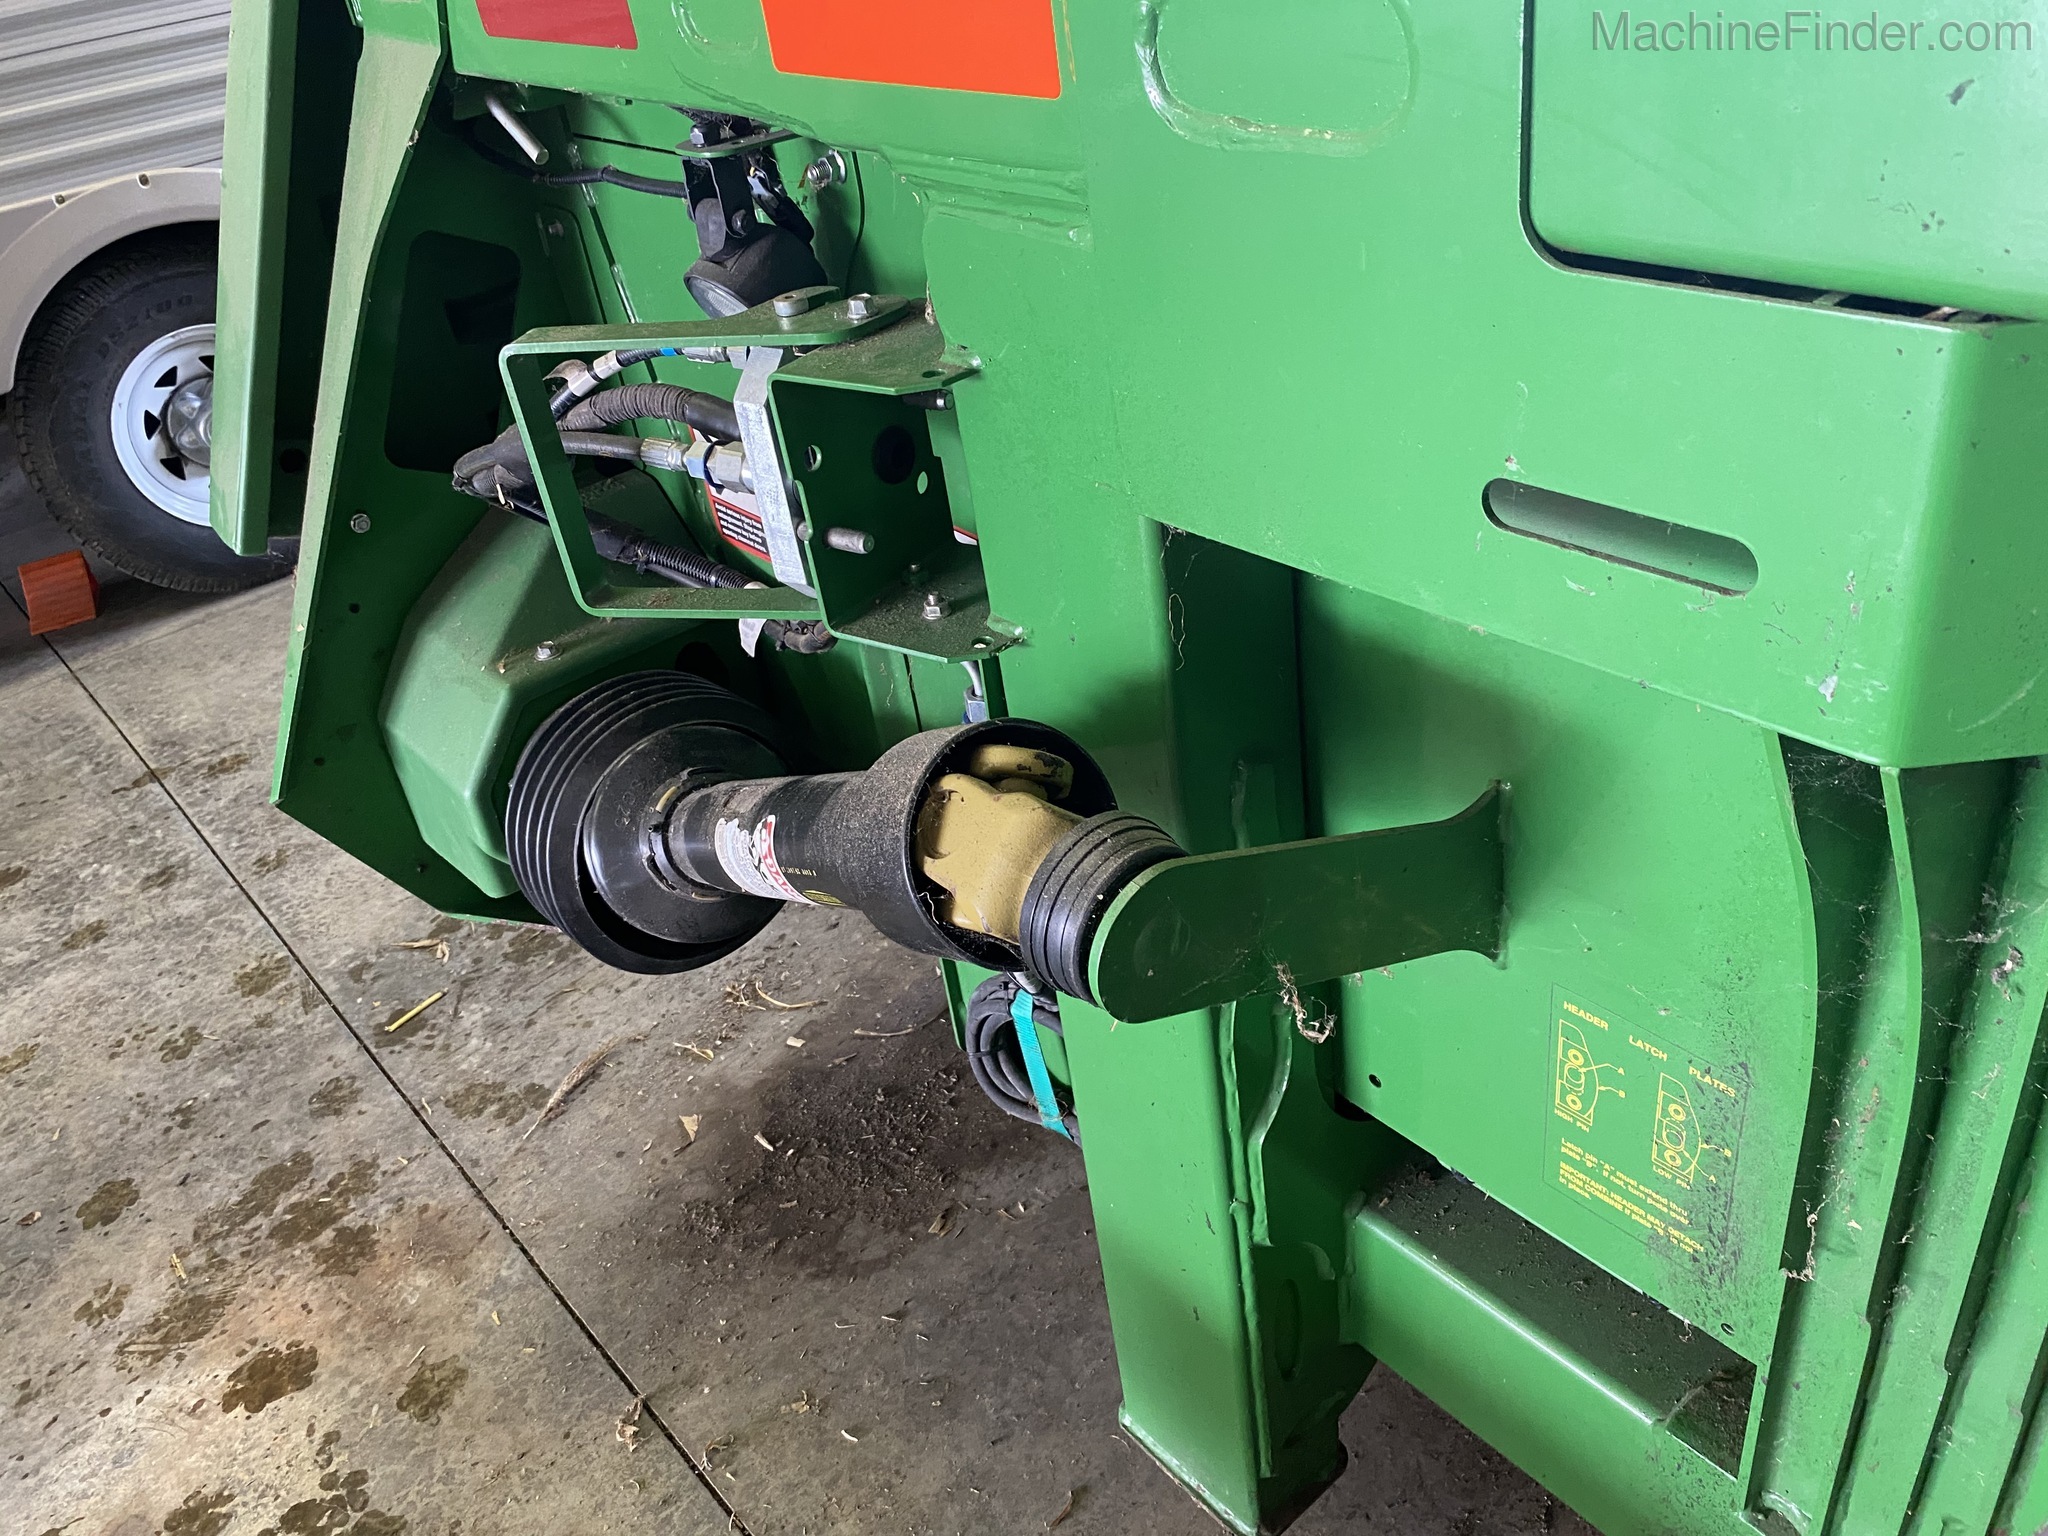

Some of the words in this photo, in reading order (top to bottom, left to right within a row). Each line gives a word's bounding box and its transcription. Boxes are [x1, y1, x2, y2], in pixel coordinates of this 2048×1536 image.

[1563, 1001, 1609, 1031] HEADER
[1629, 1034, 1668, 1062] LATCH
[1688, 1066, 1736, 1098] PLATES
[1554, 1108, 1573, 1124] HIGH
[1576, 1121, 1590, 1133] PIN
[1560, 1168, 1584, 1188] FROM
[1584, 1183, 1624, 1212] COMBINE
[1631, 1212, 1653, 1229] plate
[1561, 1146, 1581, 1162] plate
[1628, 1184, 1646, 1200] turn
[1562, 1137, 1584, 1155] Latch
[1585, 1152, 1598, 1164] pin
[1616, 1171, 1638, 1188] must
[1639, 1184, 1668, 1206] extend
[1653, 1165, 1672, 1180] LOW
[1560, 1160, 1609, 1196] IMPORTANT:
[1610, 1191, 1646, 1218] HEADER
[1646, 1213, 1666, 1229] MAY
[1667, 1226, 1704, 1253] DETACH
